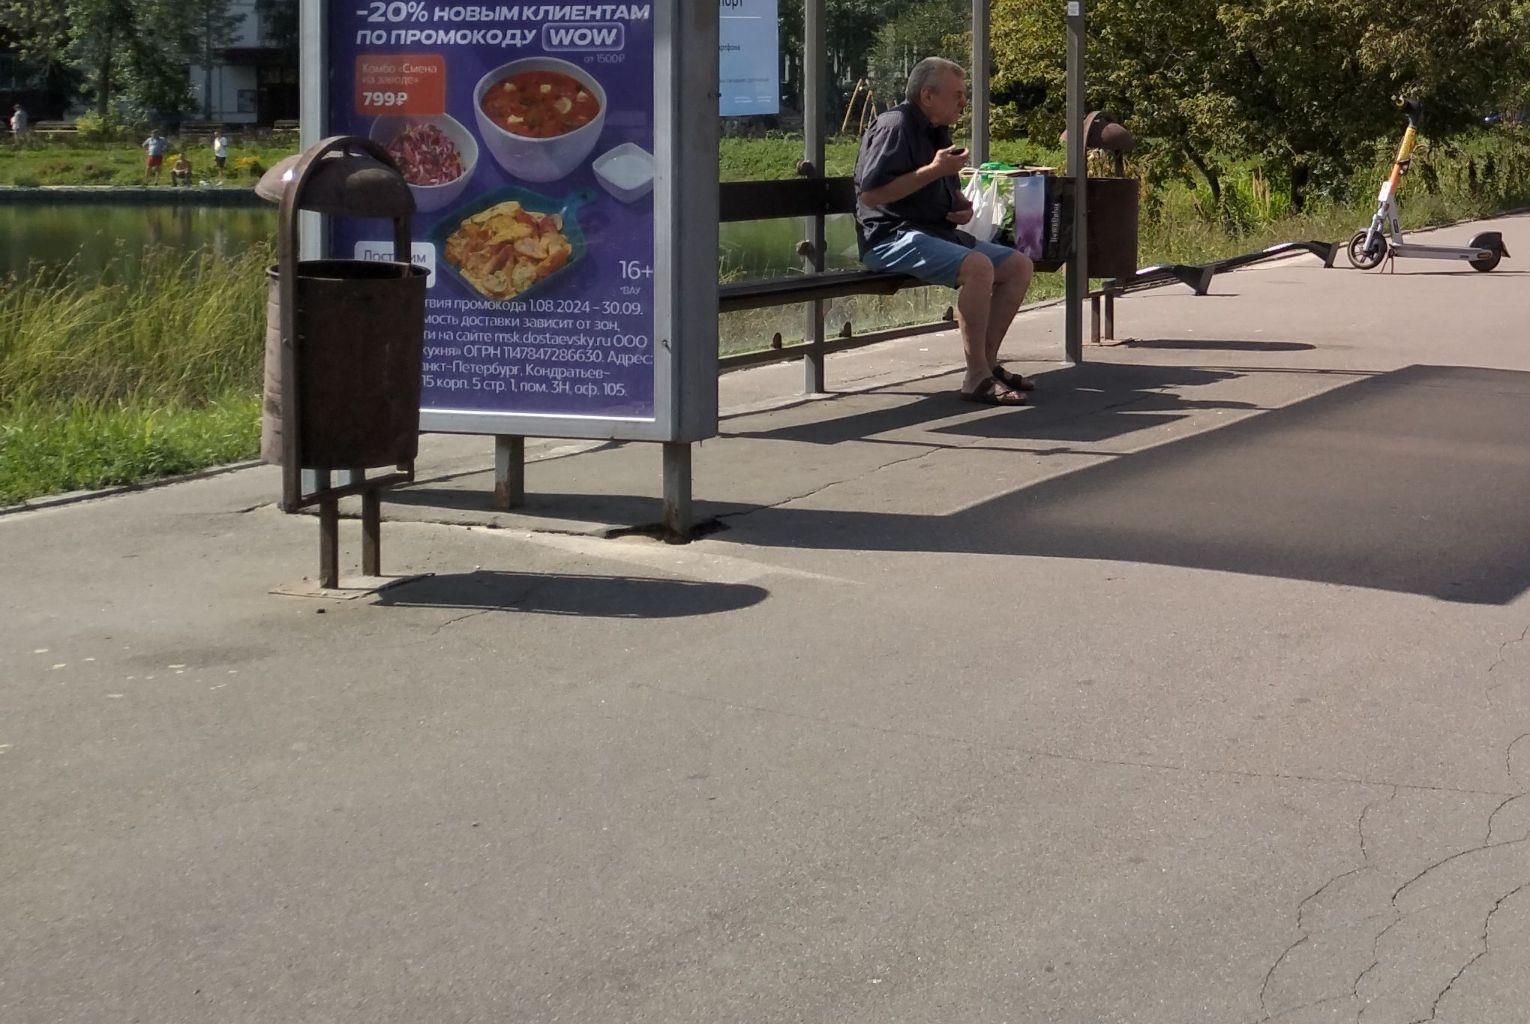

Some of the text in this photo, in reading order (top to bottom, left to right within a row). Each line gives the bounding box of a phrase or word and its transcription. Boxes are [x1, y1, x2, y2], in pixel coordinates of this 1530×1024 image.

[356, 1, 650, 22] -20% НОВЫМ КЛИЕНТАМ
[356, 29, 618, 47] ПО ПРОМОКОДУ WOW
[618, 260, 654, 280] 16+
[454, 300, 527, 313] промокода
[529, 299, 590, 314] 1.08.2024
[602, 301, 644, 315] 30.09.
[461, 316, 520, 327] доставки
[523, 318, 574, 328] зависит
[576, 320, 591, 329] от
[595, 321, 620, 332] зон,
[438, 332, 453, 341] на
[456, 330, 492, 343] сайте
[495, 331, 612, 350] msk.dostaevsky.ru
[613, 334, 648, 348] ООО
[464, 345, 500, 357] ОГРН
[473, 378, 481, 390] 5
[484, 380, 508, 393] стр.
[574, 382, 600, 397] оф.
